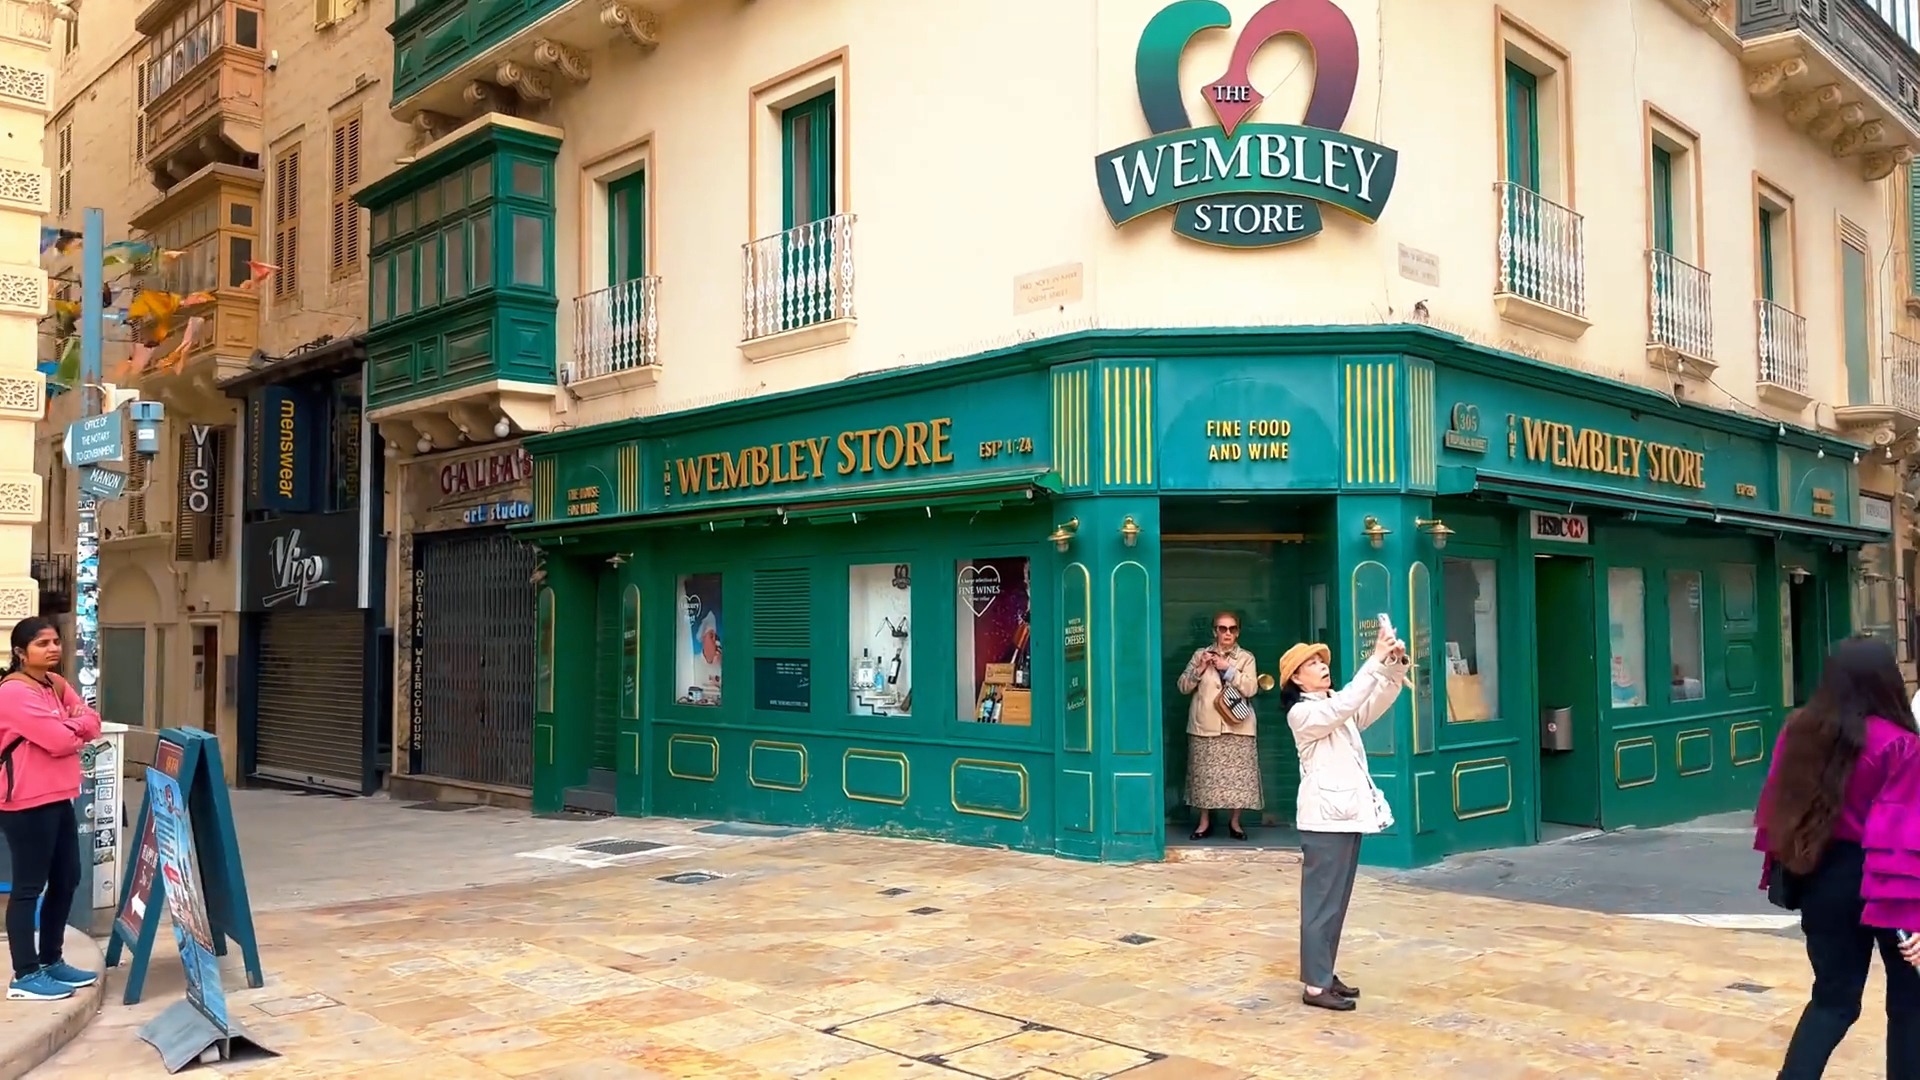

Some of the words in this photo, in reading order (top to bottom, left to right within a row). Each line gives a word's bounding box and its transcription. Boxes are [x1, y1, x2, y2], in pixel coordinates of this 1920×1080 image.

[1213, 85, 1250, 102] THE
[1110, 133, 1383, 206] WEMBLEY
[1193, 203, 1305, 234] STORE
[84, 419, 100, 431] OFFICE
[100, 416, 108, 427] OF
[1207, 420, 1241, 437] FINE
[1249, 419, 1291, 437] FOOD
[1460, 413, 1477, 432] 305
[81, 435, 91, 446] THE
[91, 431, 110, 444] NOTARY
[76, 451, 84, 461] TO
[279, 399, 295, 499] menswear
[676, 436, 830, 495] WEMBLEY
[837, 417, 953, 474] STORE
[1209, 443, 1241, 461] AND
[1248, 442, 1289, 460] WINE
[1522, 416, 1644, 478] WEMBLEY
[1646, 441, 1706, 489] STORE
[189, 424, 211, 512] VIGO
[491, 502, 531, 520] studio
[1537, 515, 1568, 537] HSBC
[269, 529, 323, 606] Vigo
[959, 586, 975, 595] FINE
[976, 585, 1000, 594] WINES
[415, 570, 424, 637] ORIGINAL
[1065, 633, 1085, 646] CHEESES
[414, 648, 423, 750] WATERCOLOURS
